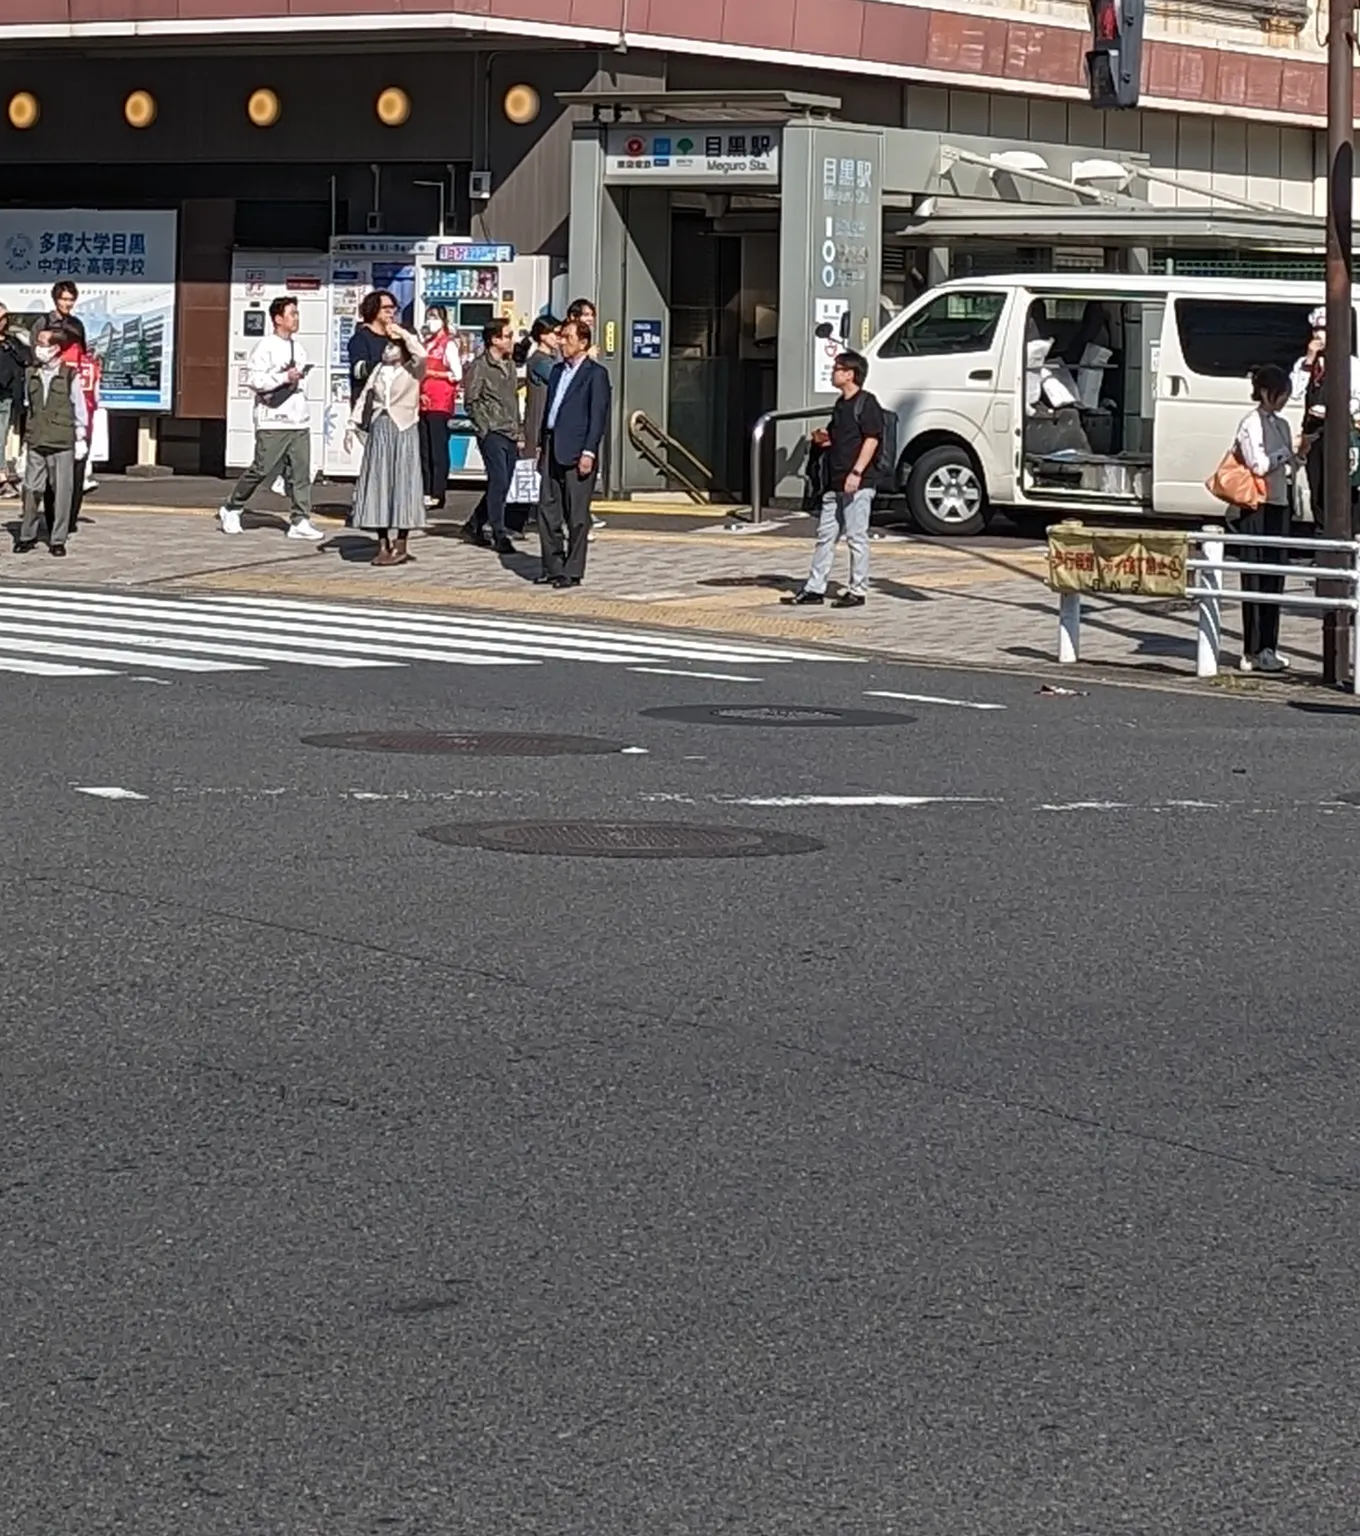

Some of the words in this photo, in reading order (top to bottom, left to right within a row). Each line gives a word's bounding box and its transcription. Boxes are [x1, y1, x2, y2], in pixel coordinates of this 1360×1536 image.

[706, 136, 771, 158] 目黒駅
[707, 160, 746, 174] Meguro
